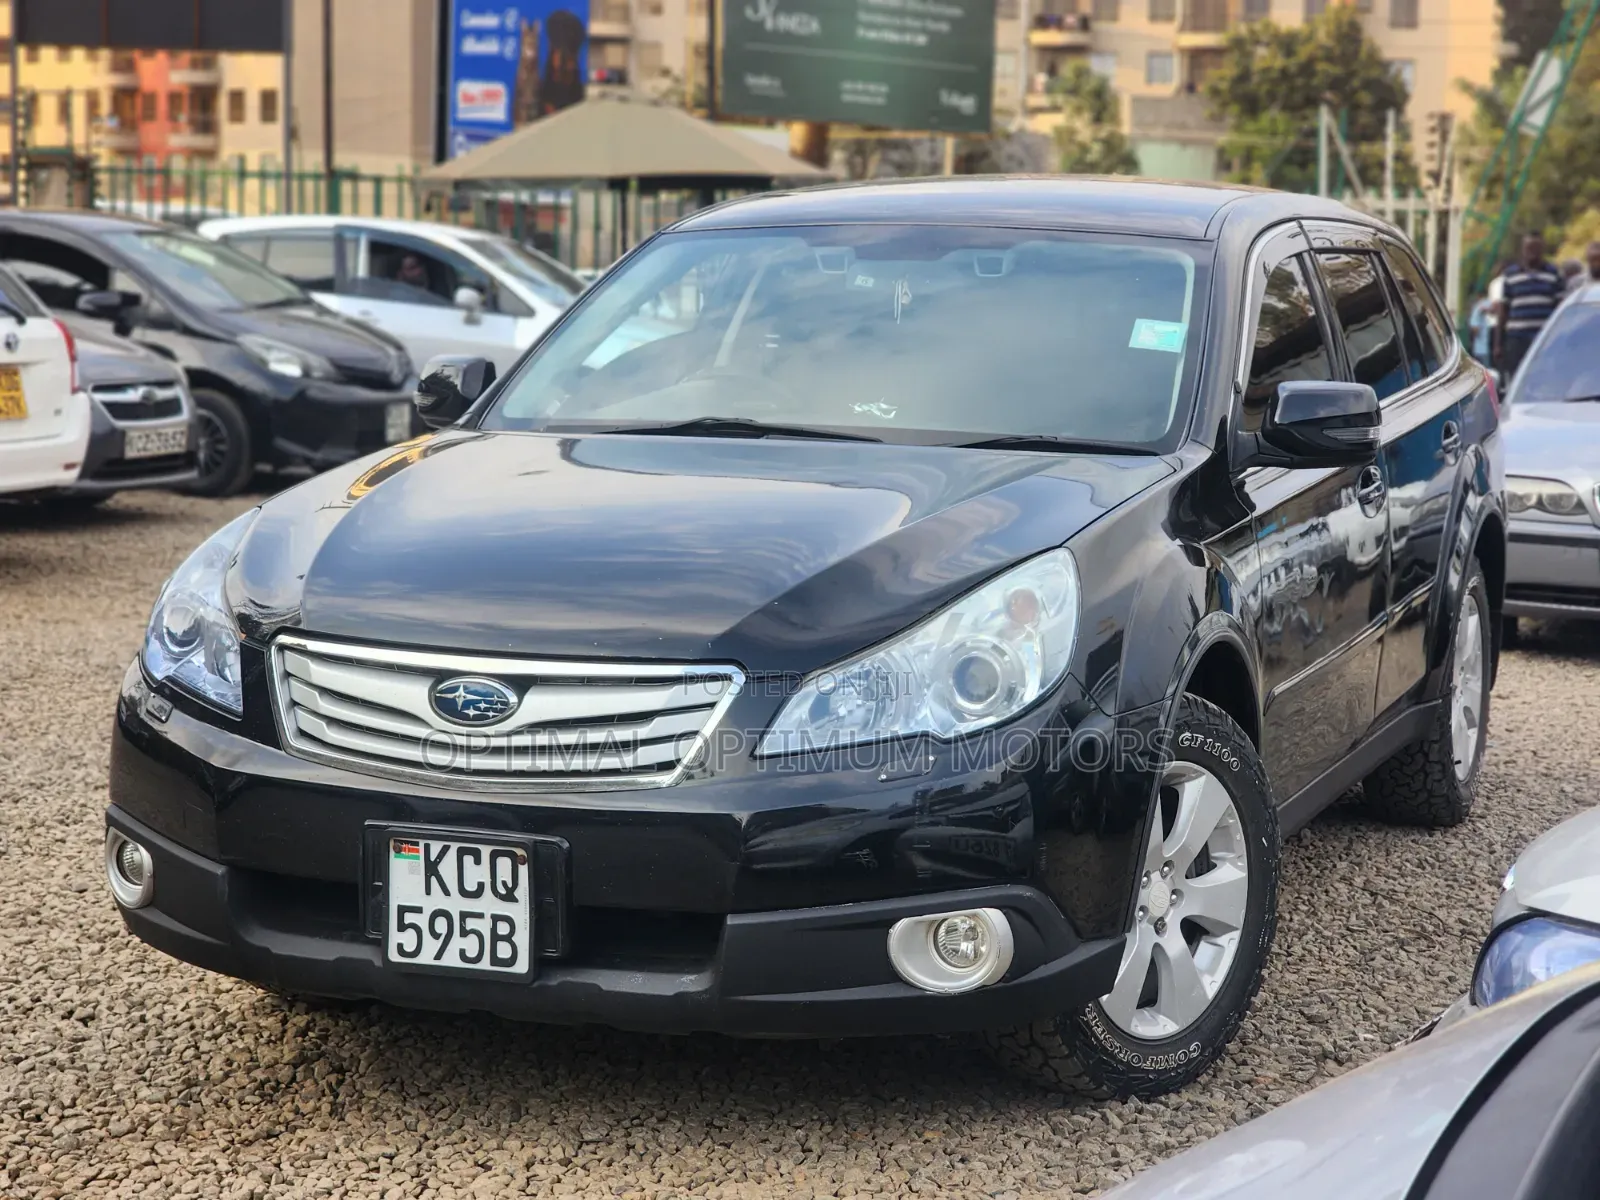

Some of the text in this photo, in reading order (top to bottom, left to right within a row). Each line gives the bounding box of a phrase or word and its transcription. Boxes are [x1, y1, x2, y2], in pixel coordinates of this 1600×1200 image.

[1178, 731, 1240, 772] CF1100
[423, 842, 520, 903] KCQ
[396, 904, 519, 968] 595B
